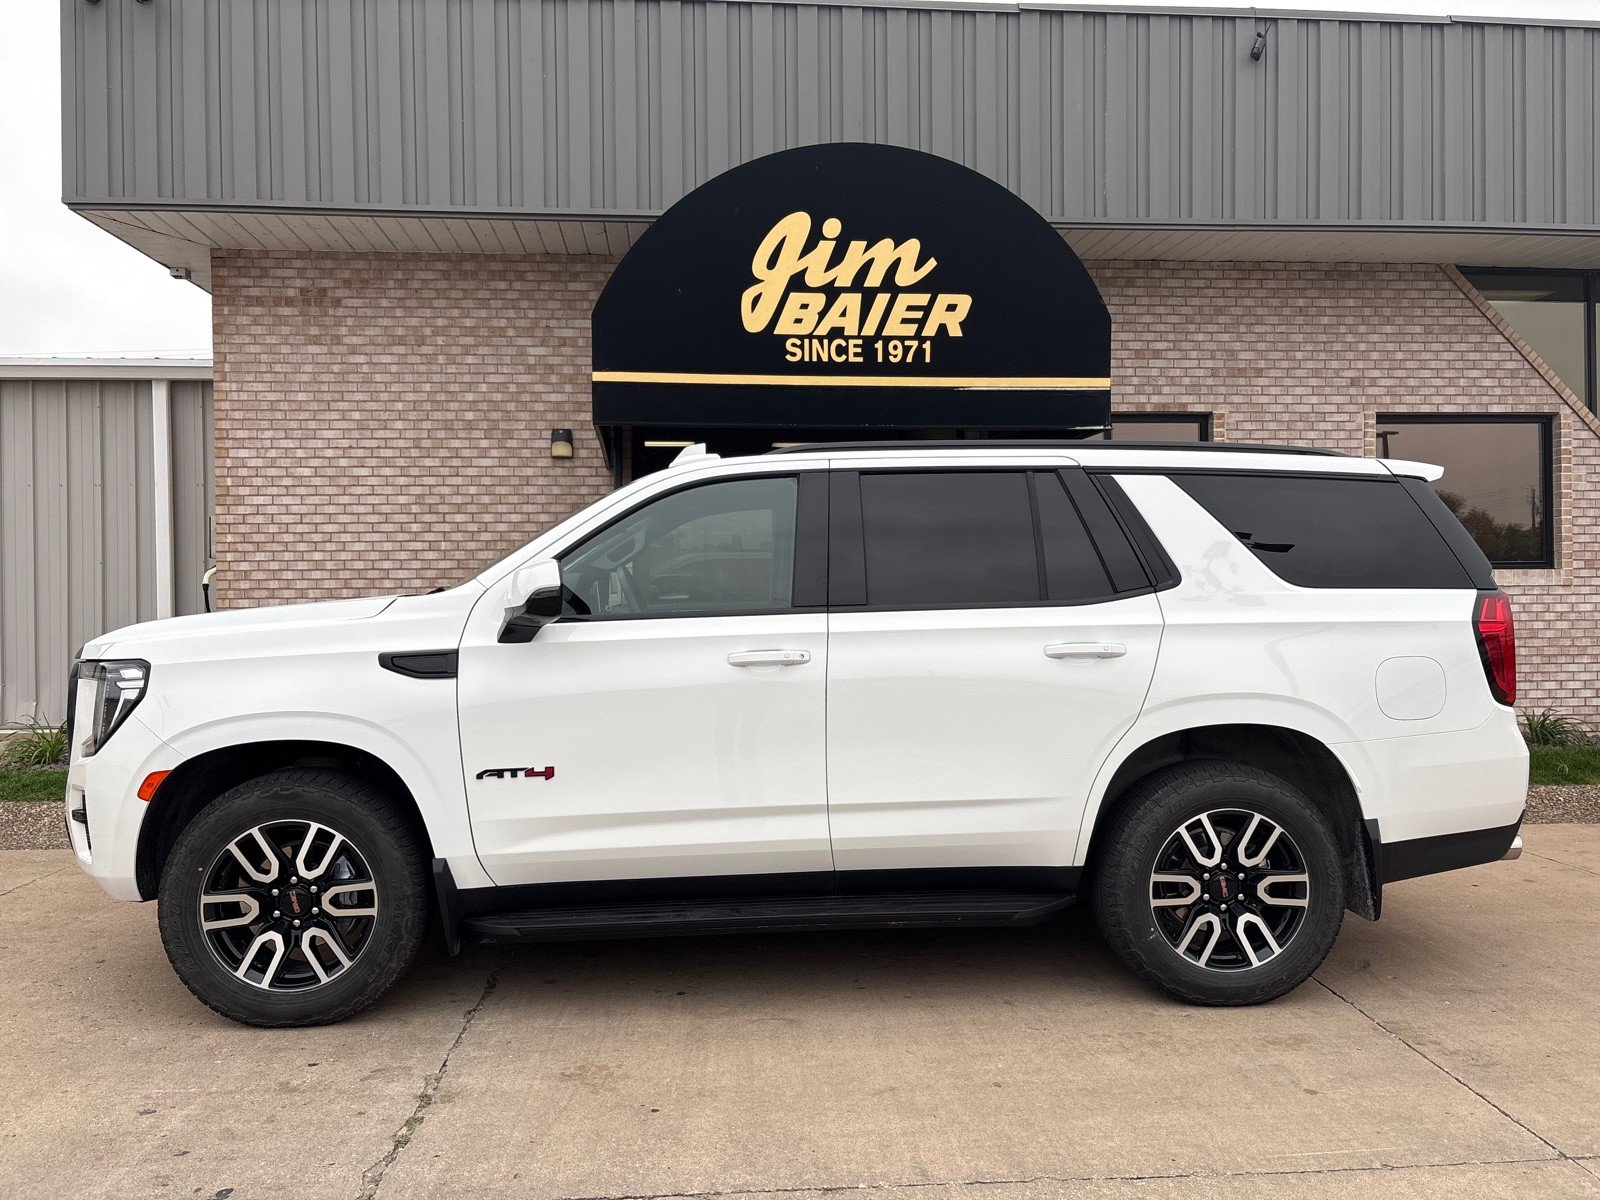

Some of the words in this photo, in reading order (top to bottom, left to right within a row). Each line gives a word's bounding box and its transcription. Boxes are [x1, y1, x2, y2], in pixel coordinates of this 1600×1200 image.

[741, 211, 938, 333] Jim
[773, 292, 973, 337] BAIER
[785, 338, 864, 363] SINCE
[874, 340, 932, 363] 1971
[475, 766, 555, 781] AT4
[290, 890, 301, 914] GMC
